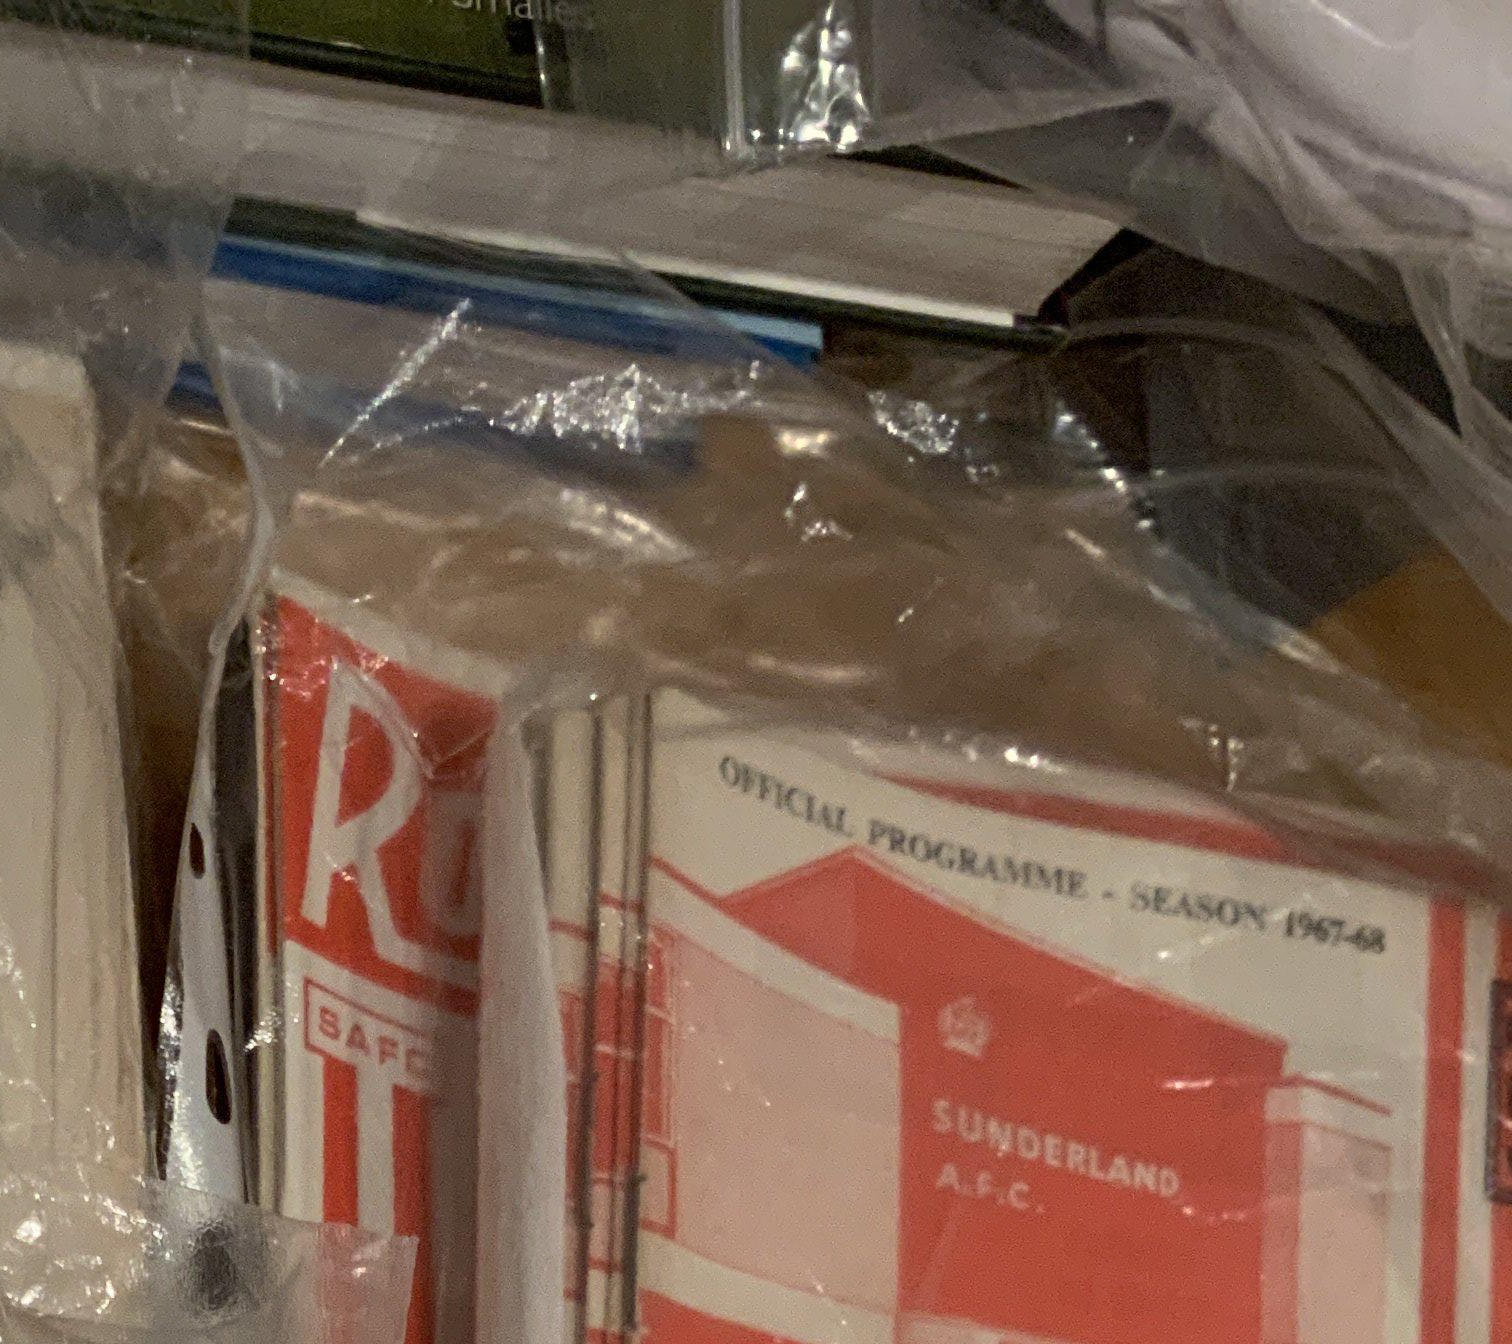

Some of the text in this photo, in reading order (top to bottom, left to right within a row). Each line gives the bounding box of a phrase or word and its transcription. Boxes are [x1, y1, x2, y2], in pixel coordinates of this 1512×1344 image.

[718, 756, 853, 838] OFFICIAL
[866, 819, 1087, 899] PROGRAMME
[1130, 881, 1267, 931] SEASON
[1285, 910, 1386, 955] 1967-68
[932, 1100, 1180, 1198] SUNDERLAND
